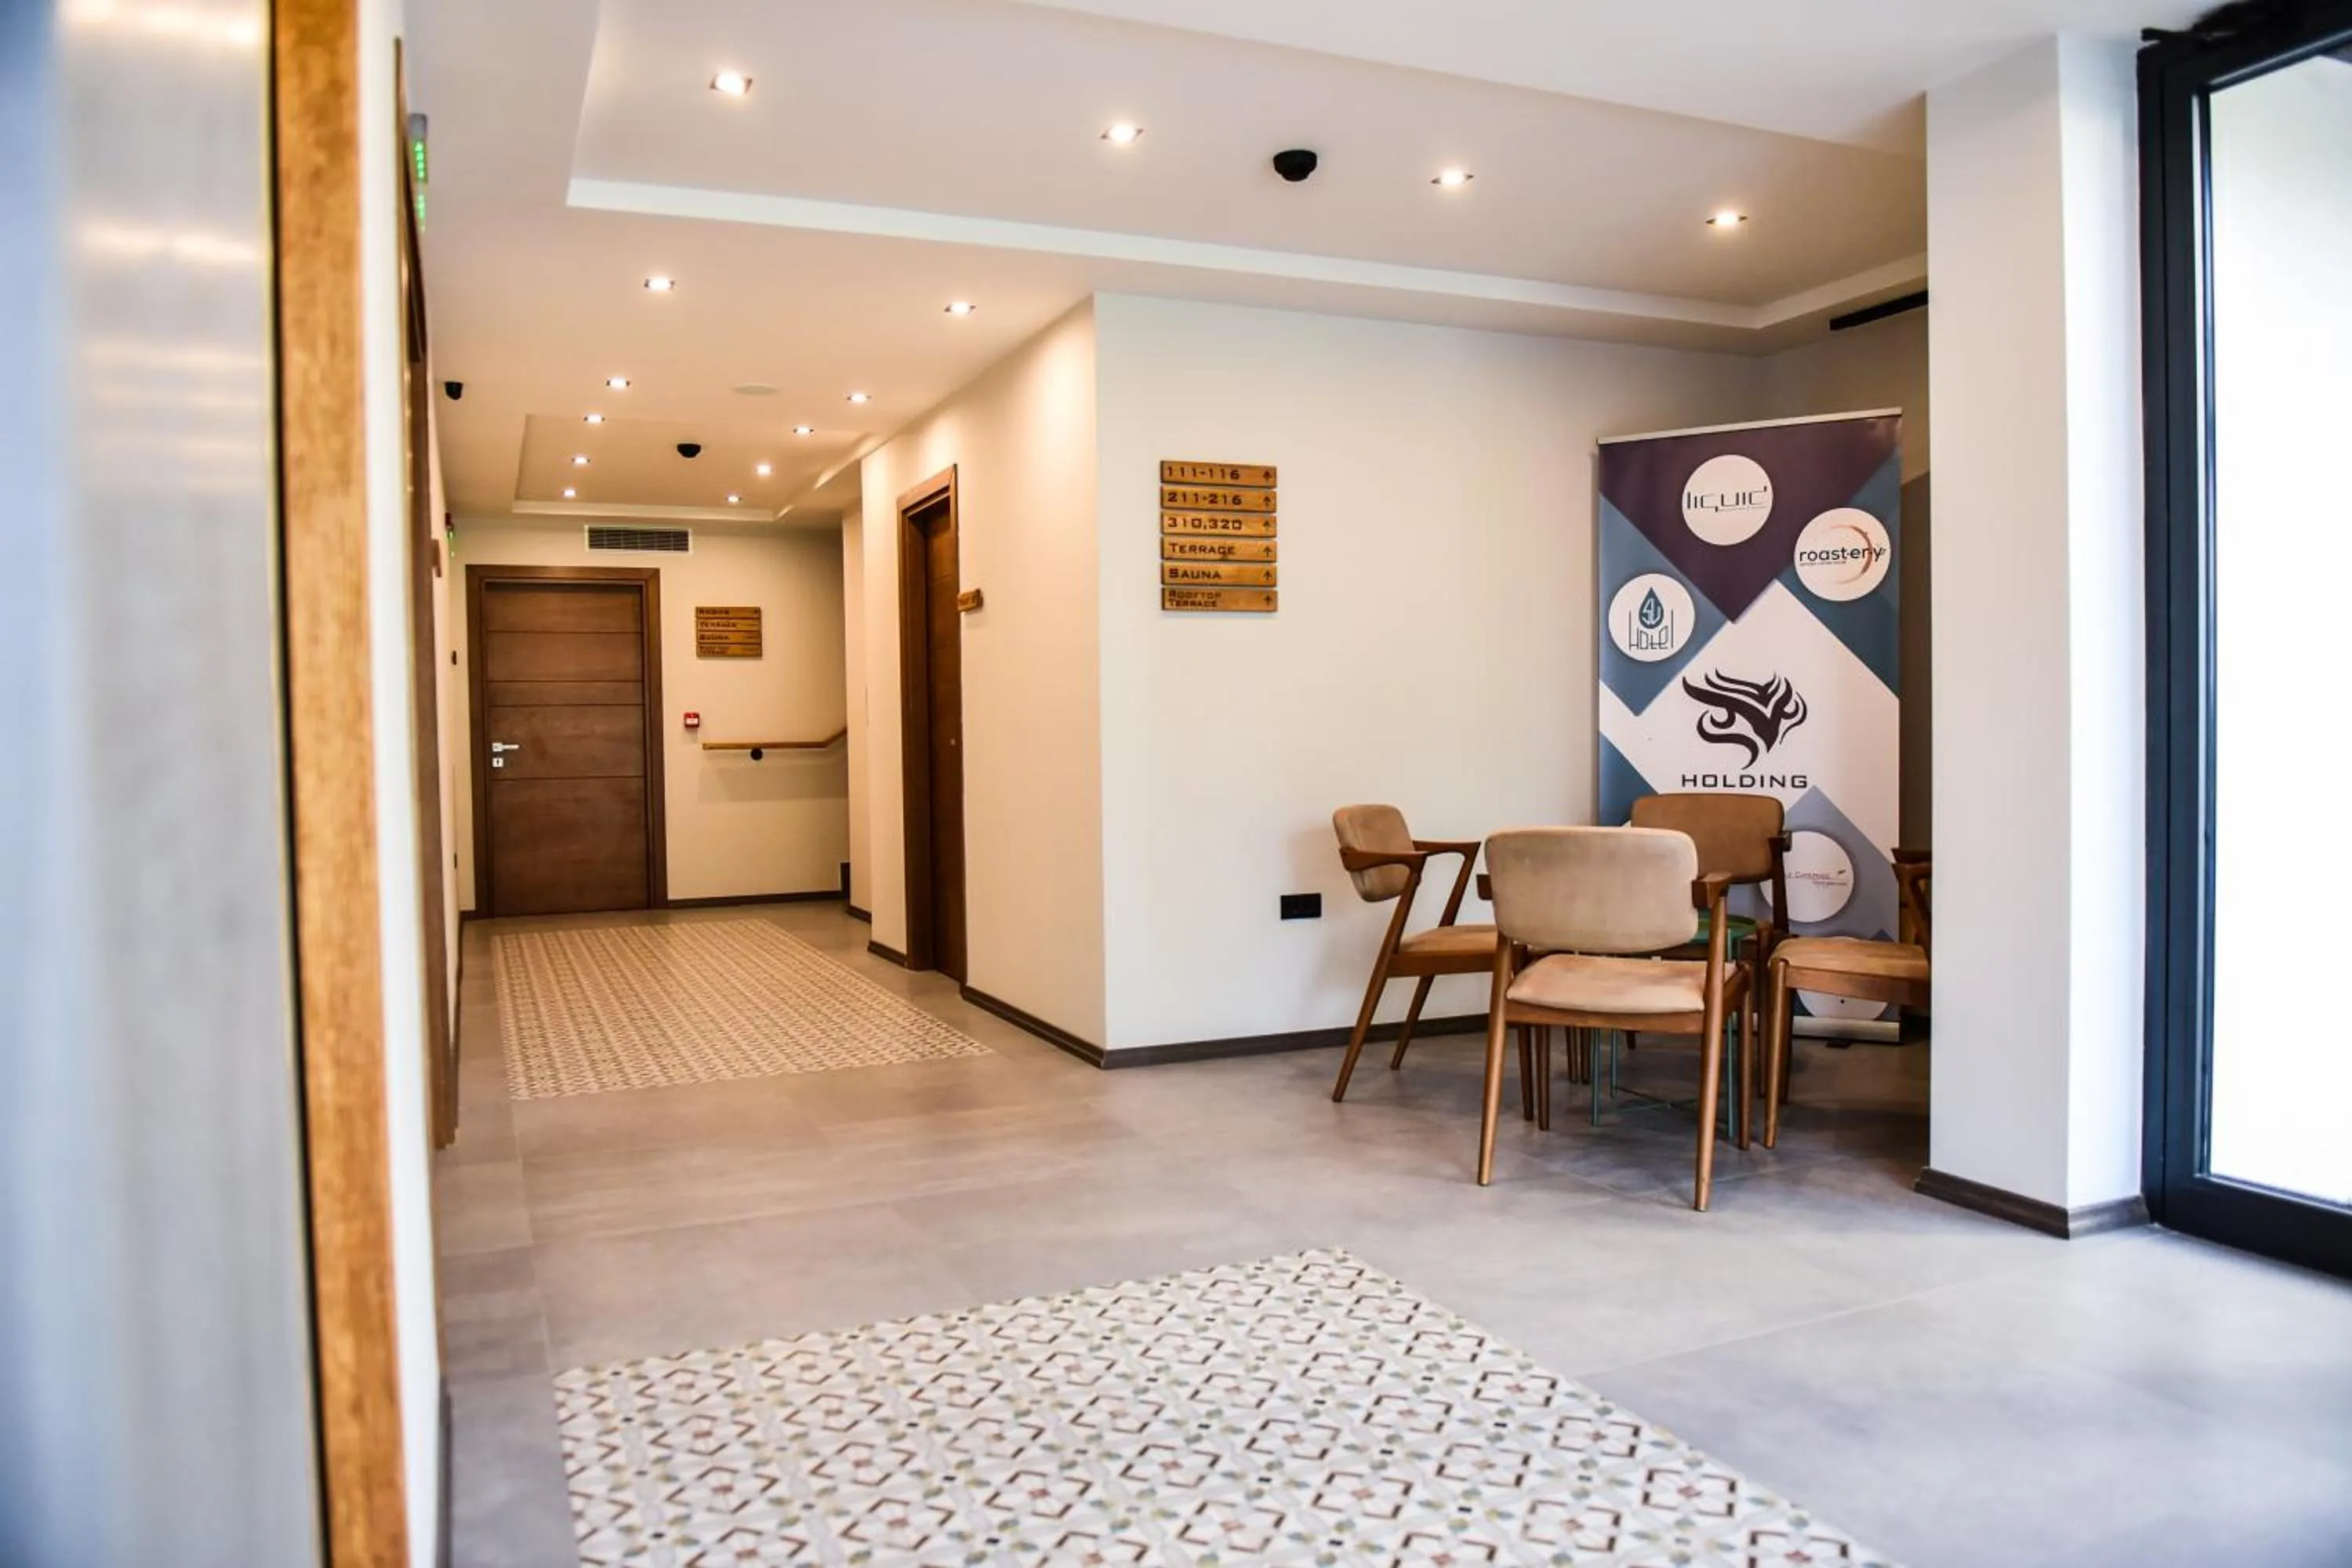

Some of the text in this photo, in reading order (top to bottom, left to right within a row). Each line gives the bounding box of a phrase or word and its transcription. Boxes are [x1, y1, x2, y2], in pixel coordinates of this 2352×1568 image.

[1167, 466, 1240, 481] 111-116
[1167, 492, 1243, 506] 211-216
[1167, 517, 1243, 530] 310,320
[1169, 568, 1223, 580] SAUNA
[1681, 774, 1807, 789] HOLDING
